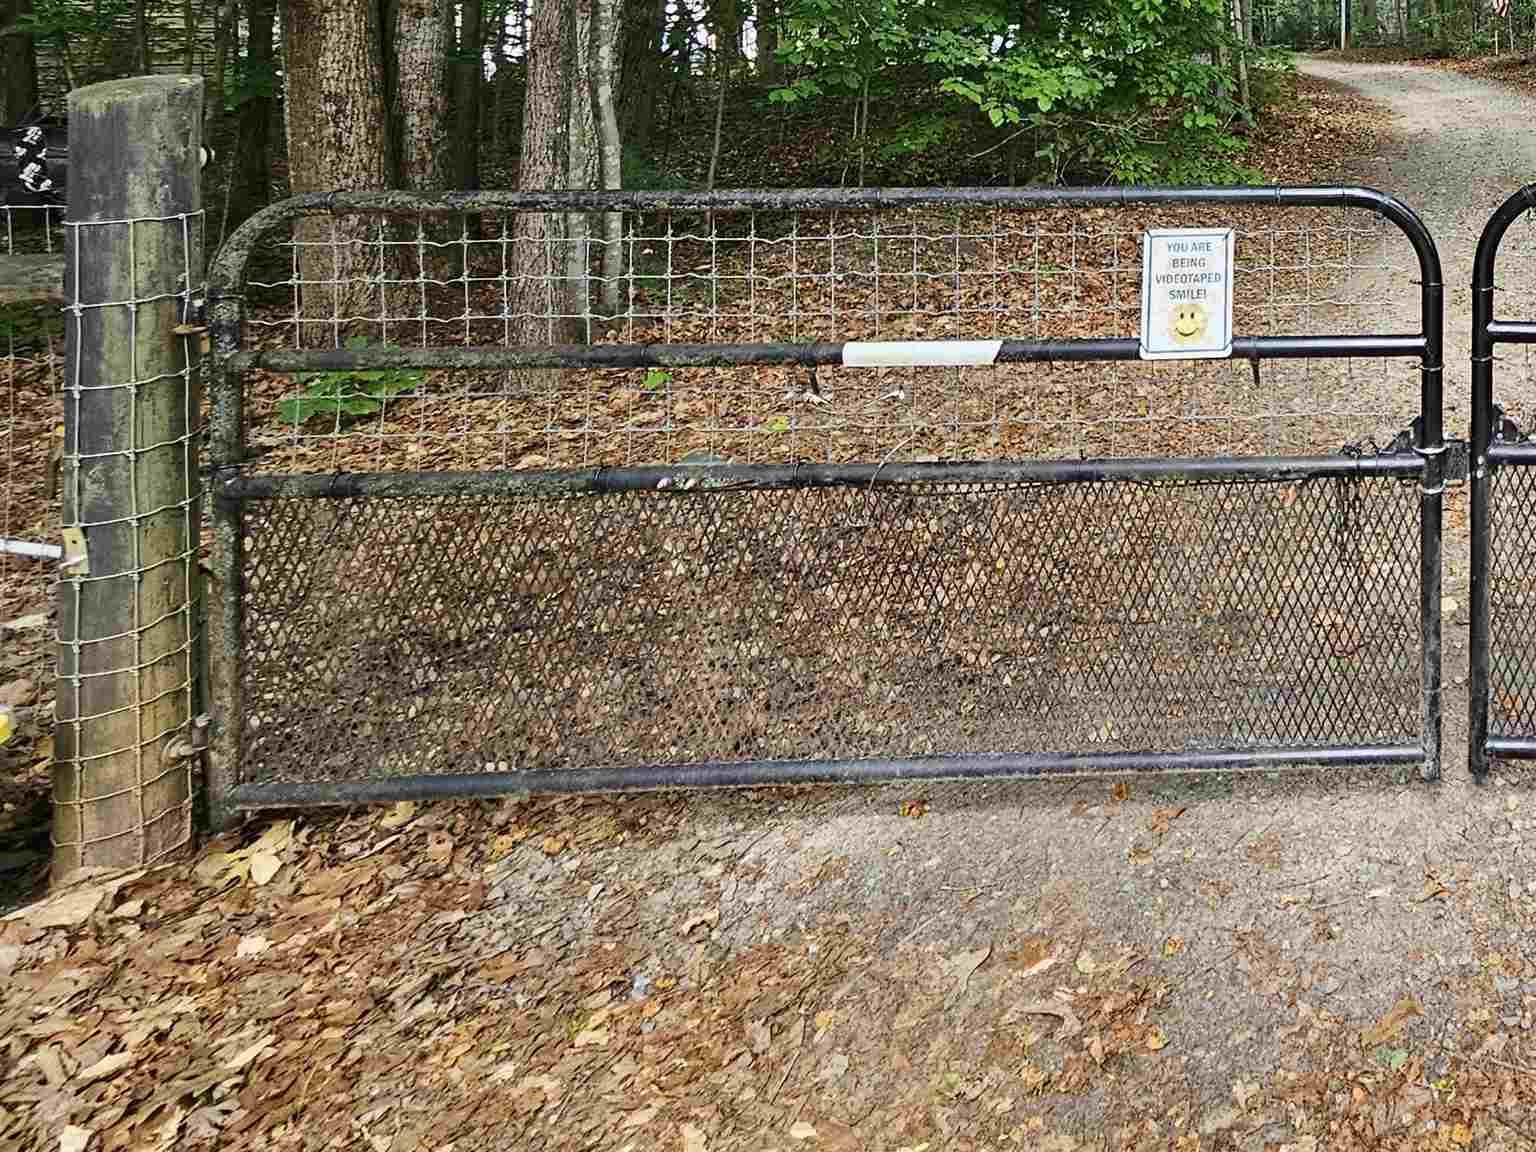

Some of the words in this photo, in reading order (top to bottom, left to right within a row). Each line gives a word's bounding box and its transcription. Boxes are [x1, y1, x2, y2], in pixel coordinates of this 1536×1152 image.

[1168, 242, 1189, 252] YOU
[1191, 242, 1213, 252] ARE
[1172, 258, 1206, 268] BEING
[1155, 273, 1222, 284] VIDEOTAPED
[1169, 289, 1207, 300] SMILE!
